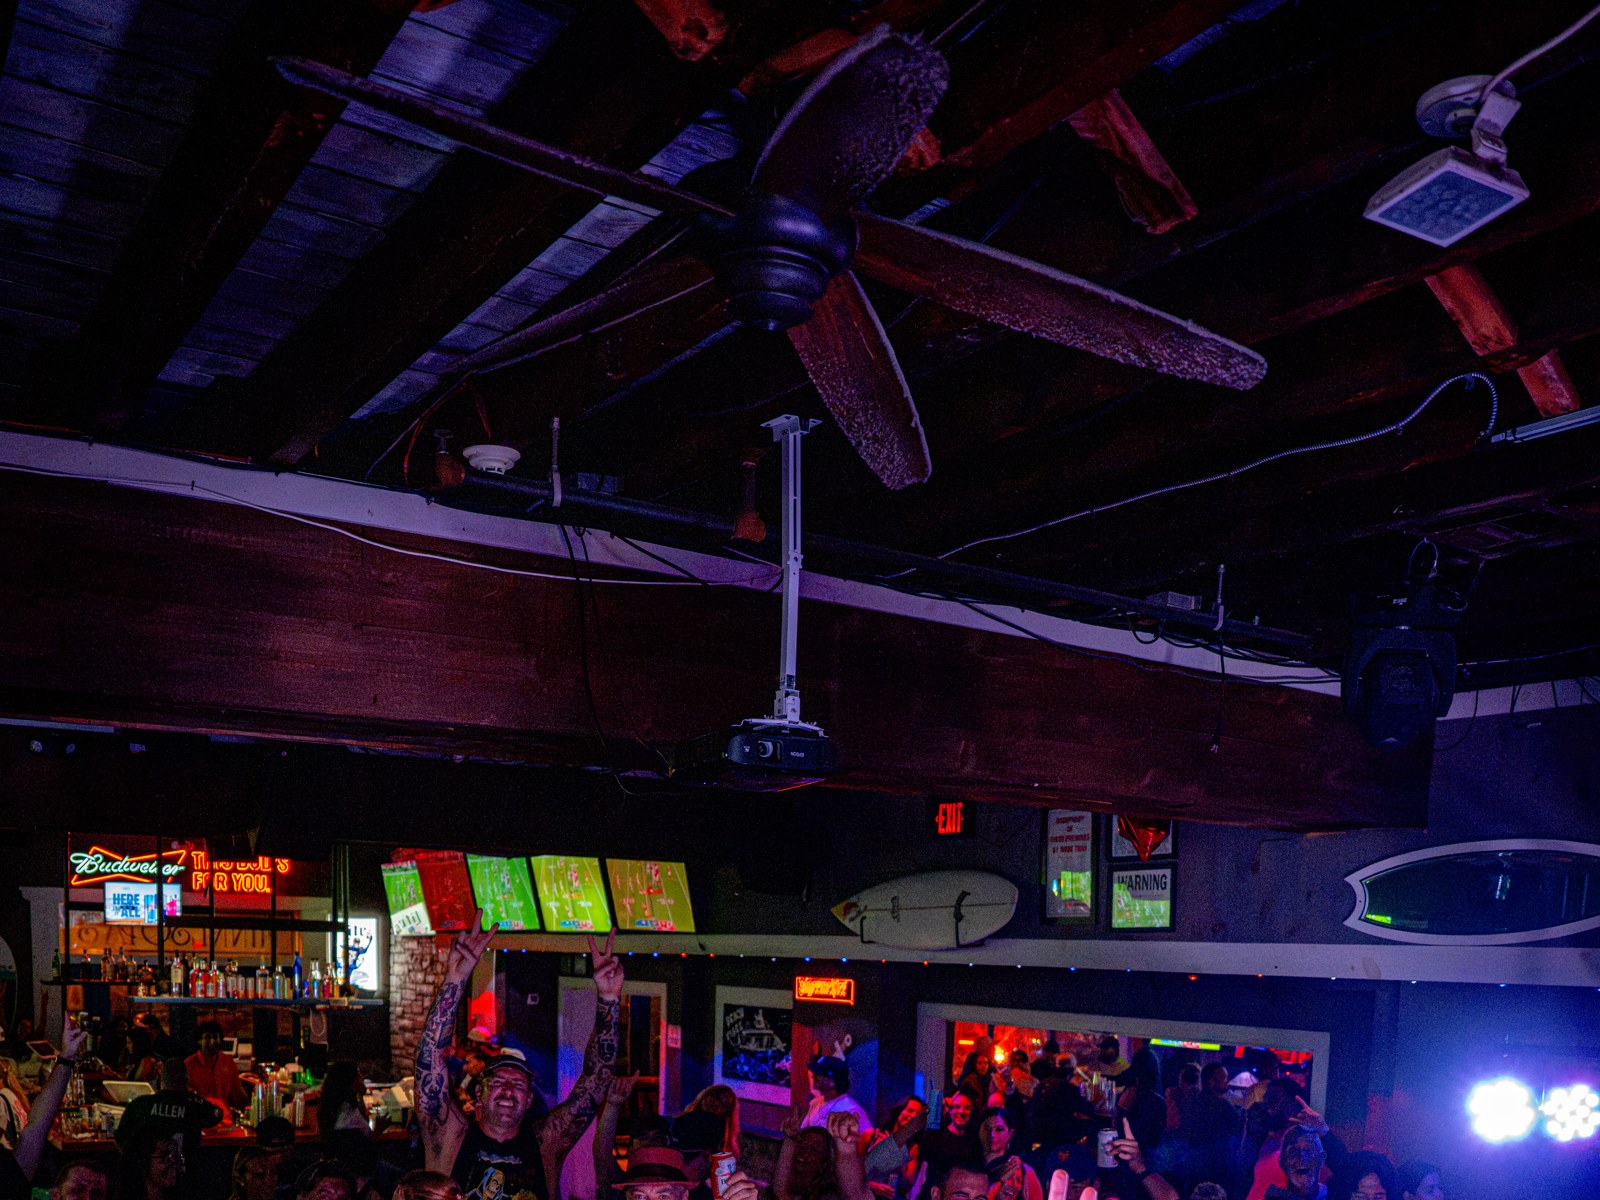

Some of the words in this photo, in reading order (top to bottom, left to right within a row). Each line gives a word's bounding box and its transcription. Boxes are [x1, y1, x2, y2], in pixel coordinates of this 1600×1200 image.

[938, 802, 963, 834] EXIT
[70, 852, 186, 875] Budweier
[231, 872, 271, 893] YOU.
[1117, 874, 1168, 891] WARNING
[113, 893, 140, 905] HERE
[121, 905, 141, 917] ALL
[150, 1103, 186, 1119] ALLEN
